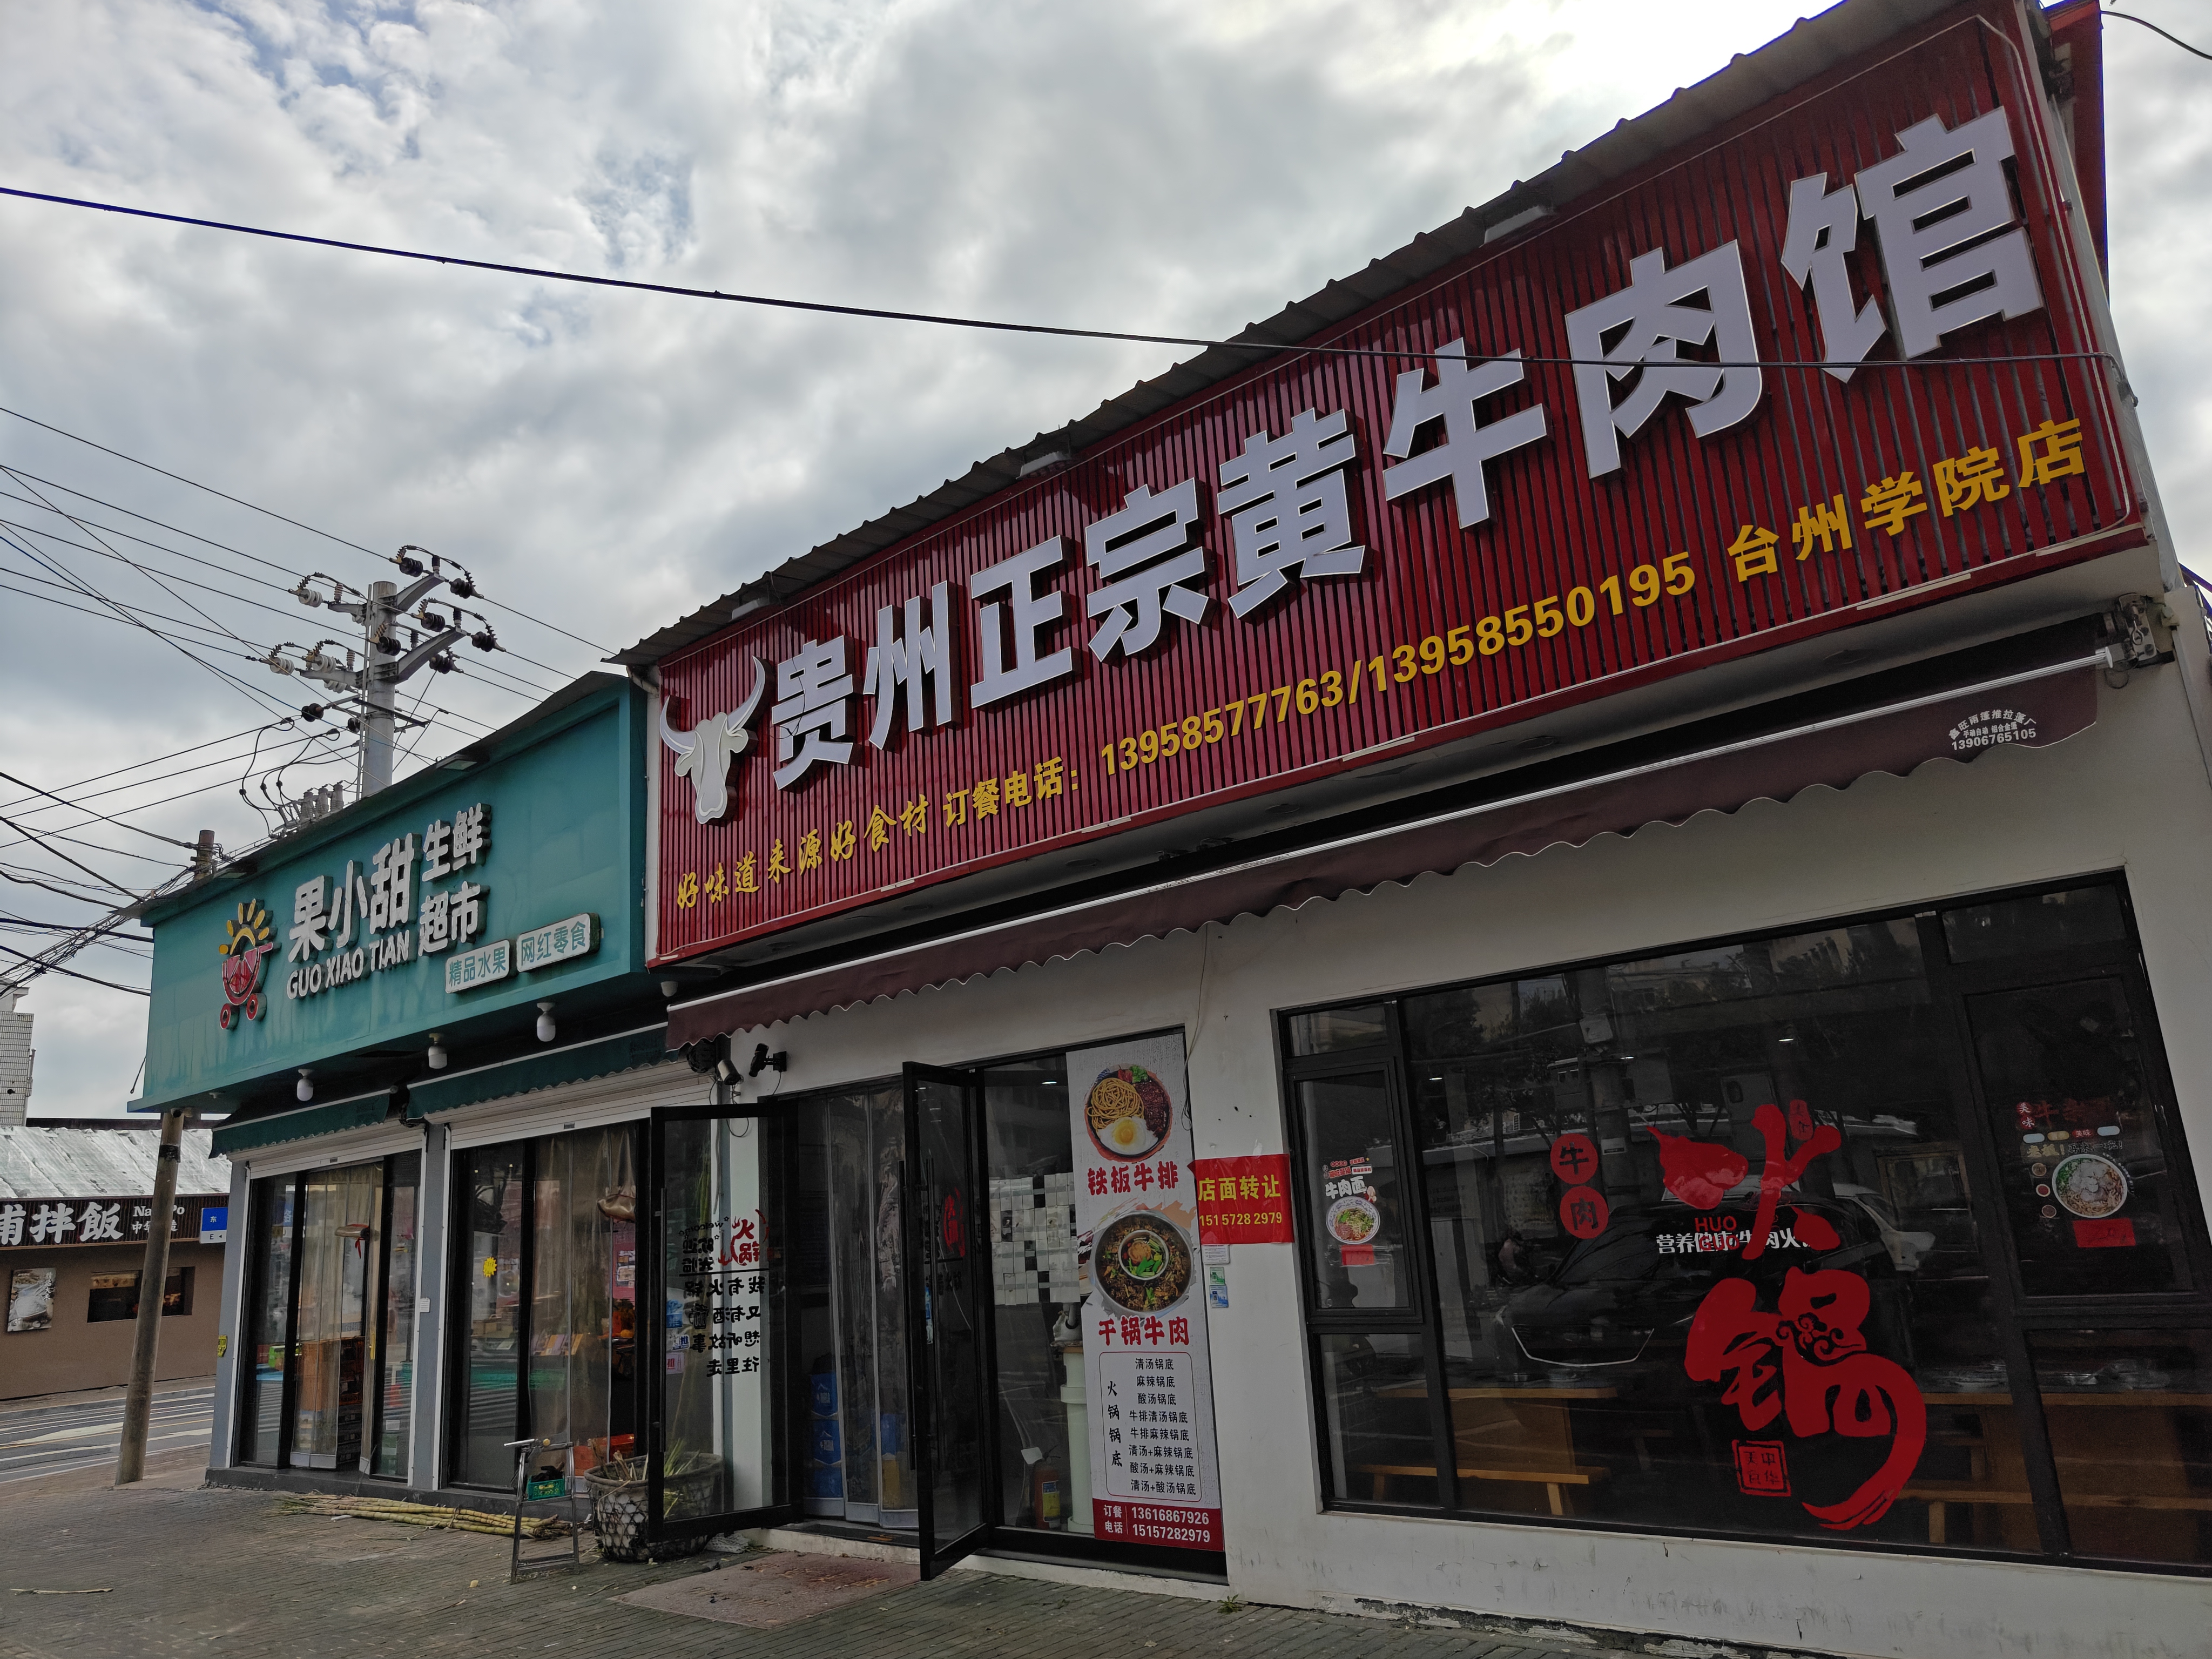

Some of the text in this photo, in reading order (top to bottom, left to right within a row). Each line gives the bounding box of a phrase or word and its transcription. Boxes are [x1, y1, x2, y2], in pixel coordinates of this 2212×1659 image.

[772, 106, 2044, 791] 贵州正宗黄牛肉馆
[677, 794, 930, 909] 好味道来源好食材
[1101, 551, 1696, 775] 13958577763/13958550195
[1727, 418, 2086, 583] 台州学院店
[1951, 728, 2036, 751] 13906765105
[422, 802, 483, 882] 生鲜
[288, 832, 415, 963] 果小甜
[418, 881, 480, 957] 超市
[521, 921, 586, 966] 网红零食
[287, 929, 410, 1000] GUO XIAO TIAN
[449, 946, 507, 987] 精品水果
[1087, 1161, 1178, 1196] 铁板牛排
[1198, 1174, 1281, 1202] 店面转让
[1325, 1175, 1367, 1199] 牛肉面
[1559, 1141, 1599, 1231] 牛肉
[1694, 1215, 1737, 1232] HUO
[1098, 1316, 1189, 1346] 干锅牛肉
[1135, 1358, 1174, 1371] 清汤锅底
[1137, 1375, 1175, 1388] 麻辣锅底
[1137, 1393, 1177, 1405] 酸汤锅底
[1107, 1380, 1123, 1467] 火锅锅底
[1129, 1410, 1188, 1424] 牛排清汤锅底
[1130, 1427, 1189, 1441] 牛排麻辣锅底
[1129, 1445, 1193, 1459] 清汤+麻辣锅底
[1130, 1462, 1195, 1477] 酸汤+麻辣锅底
[1131, 1479, 1196, 1495] 清汤+酸汤锅底
[1103, 1505, 1209, 1525] 订餐 13616867926
[1104, 1520, 1210, 1543] 电话 15157282979
